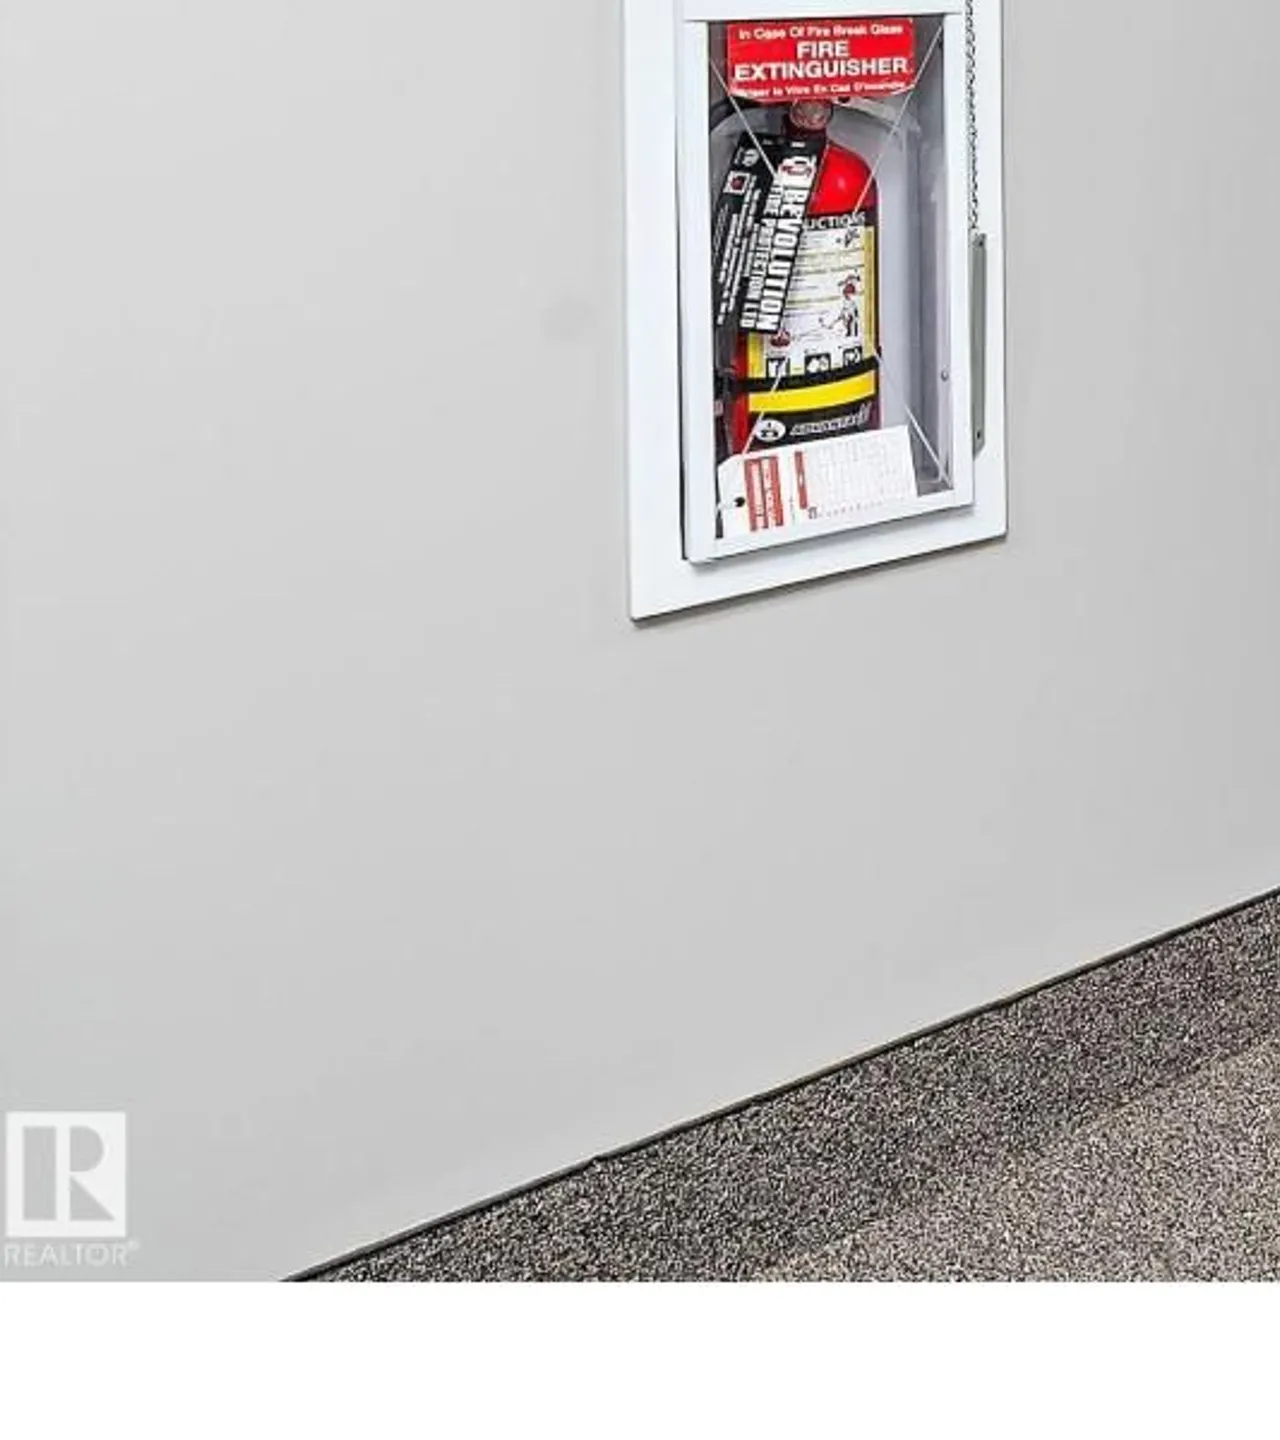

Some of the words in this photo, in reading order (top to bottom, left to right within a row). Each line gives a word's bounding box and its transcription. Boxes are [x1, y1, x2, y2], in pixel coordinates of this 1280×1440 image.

[739, 28, 751, 40] In
[754, 28, 786, 40] Case
[797, 40, 850, 60] FIRE
[734, 56, 907, 82] EXTINGUISHER
[756, 189, 811, 331] REVOLUTION
